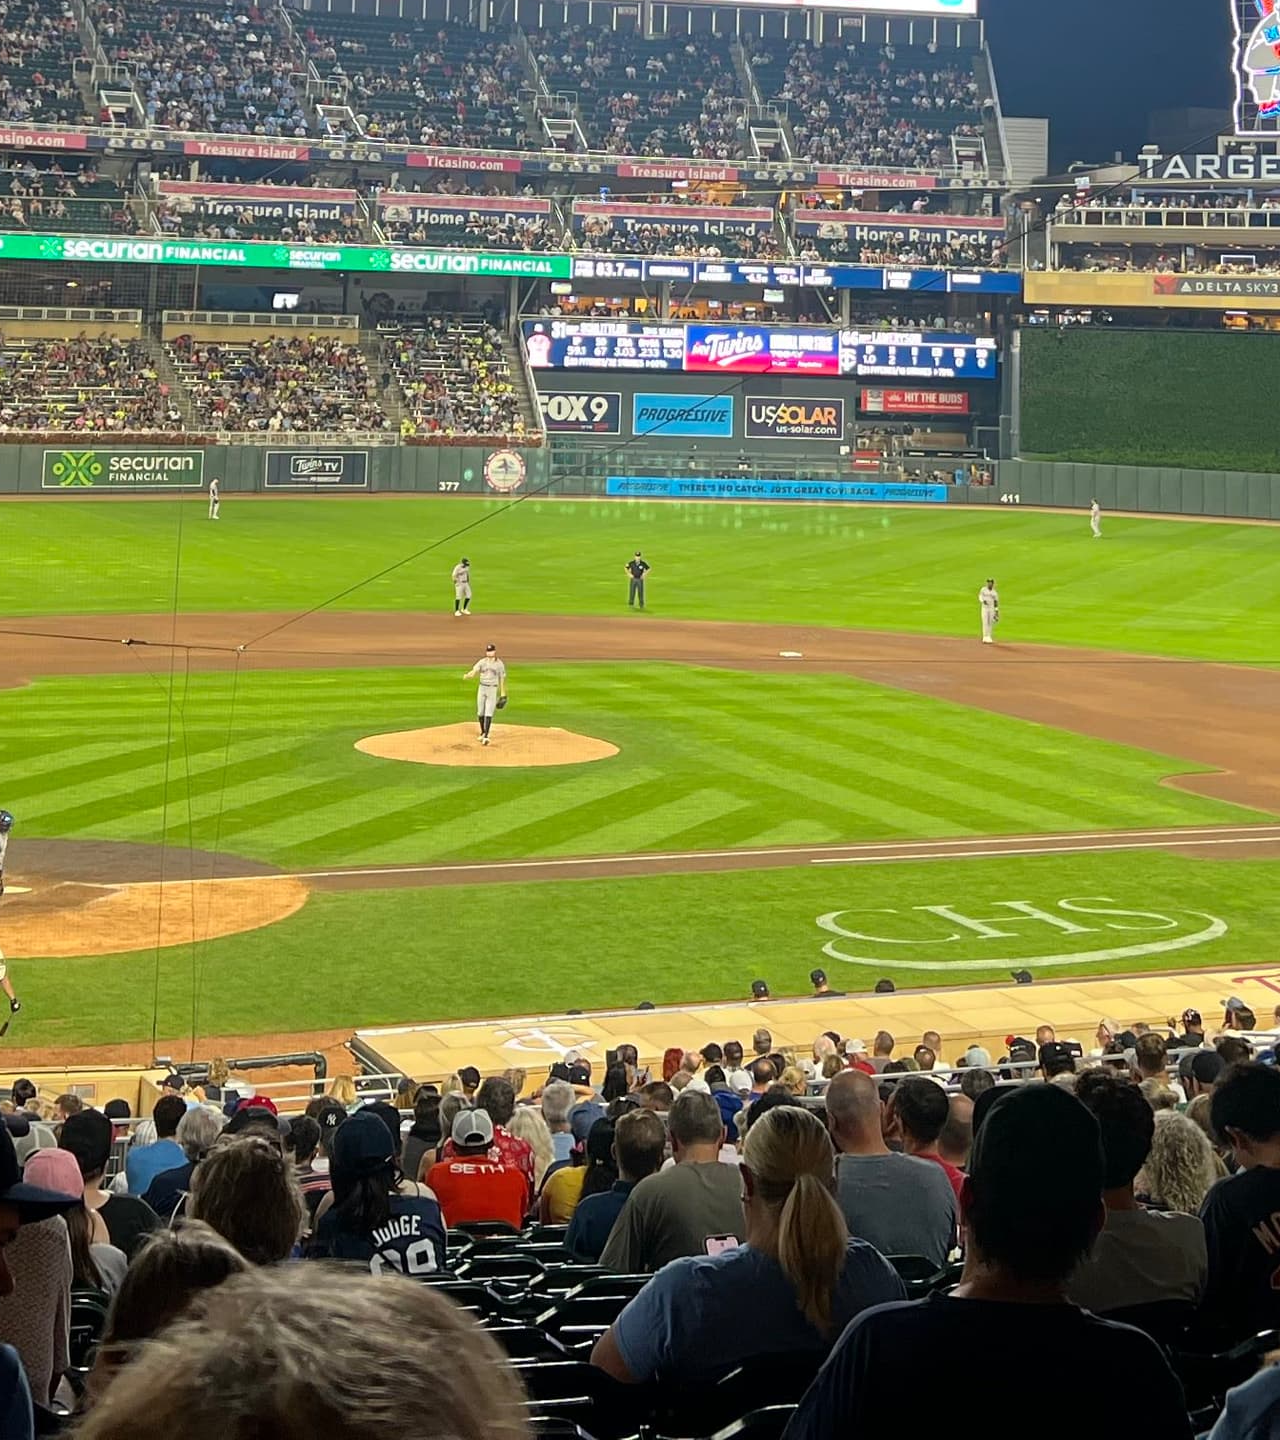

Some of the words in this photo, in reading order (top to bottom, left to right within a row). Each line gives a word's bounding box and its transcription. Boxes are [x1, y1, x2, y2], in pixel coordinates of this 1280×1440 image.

[197, 142, 255, 156] Treasure
[258, 145, 297, 160] Island
[630, 165, 685, 179] Treasure
[688, 168, 726, 181] Island
[287, 201, 340, 221] Island
[416, 207, 457, 226] Home
[703, 220, 757, 238] Island
[855, 226, 897, 243] Home
[905, 227, 936, 244] Run
[947, 229, 987, 246] Deck
[62, 239, 163, 262] securian
[165, 245, 246, 262] FINANCIAL
[390, 250, 479, 271] securian
[480, 257, 552, 274] FINANCIAL
[1195, 281, 1242, 294] DELTA
[705, 331, 764, 363] Twins
[904, 391, 920, 403] HIT
[921, 392, 937, 404] THE
[539, 397, 585, 422] FOX
[589, 396, 609, 422] 9
[637, 406, 729, 424] PROGRESSIVE
[776, 424, 838, 436] us-solar.com
[108, 456, 194, 471] securian
[296, 456, 322, 473] Twins
[324, 462, 339, 472] TV
[109, 472, 169, 481] FINANCIAL
[439, 481, 460, 491] 377
[1000, 494, 1019, 504] 411
[815, 896, 1179, 945] CHS
[450, 1162, 505, 1175] SETH
[372, 1214, 421, 1248] JUDGE
